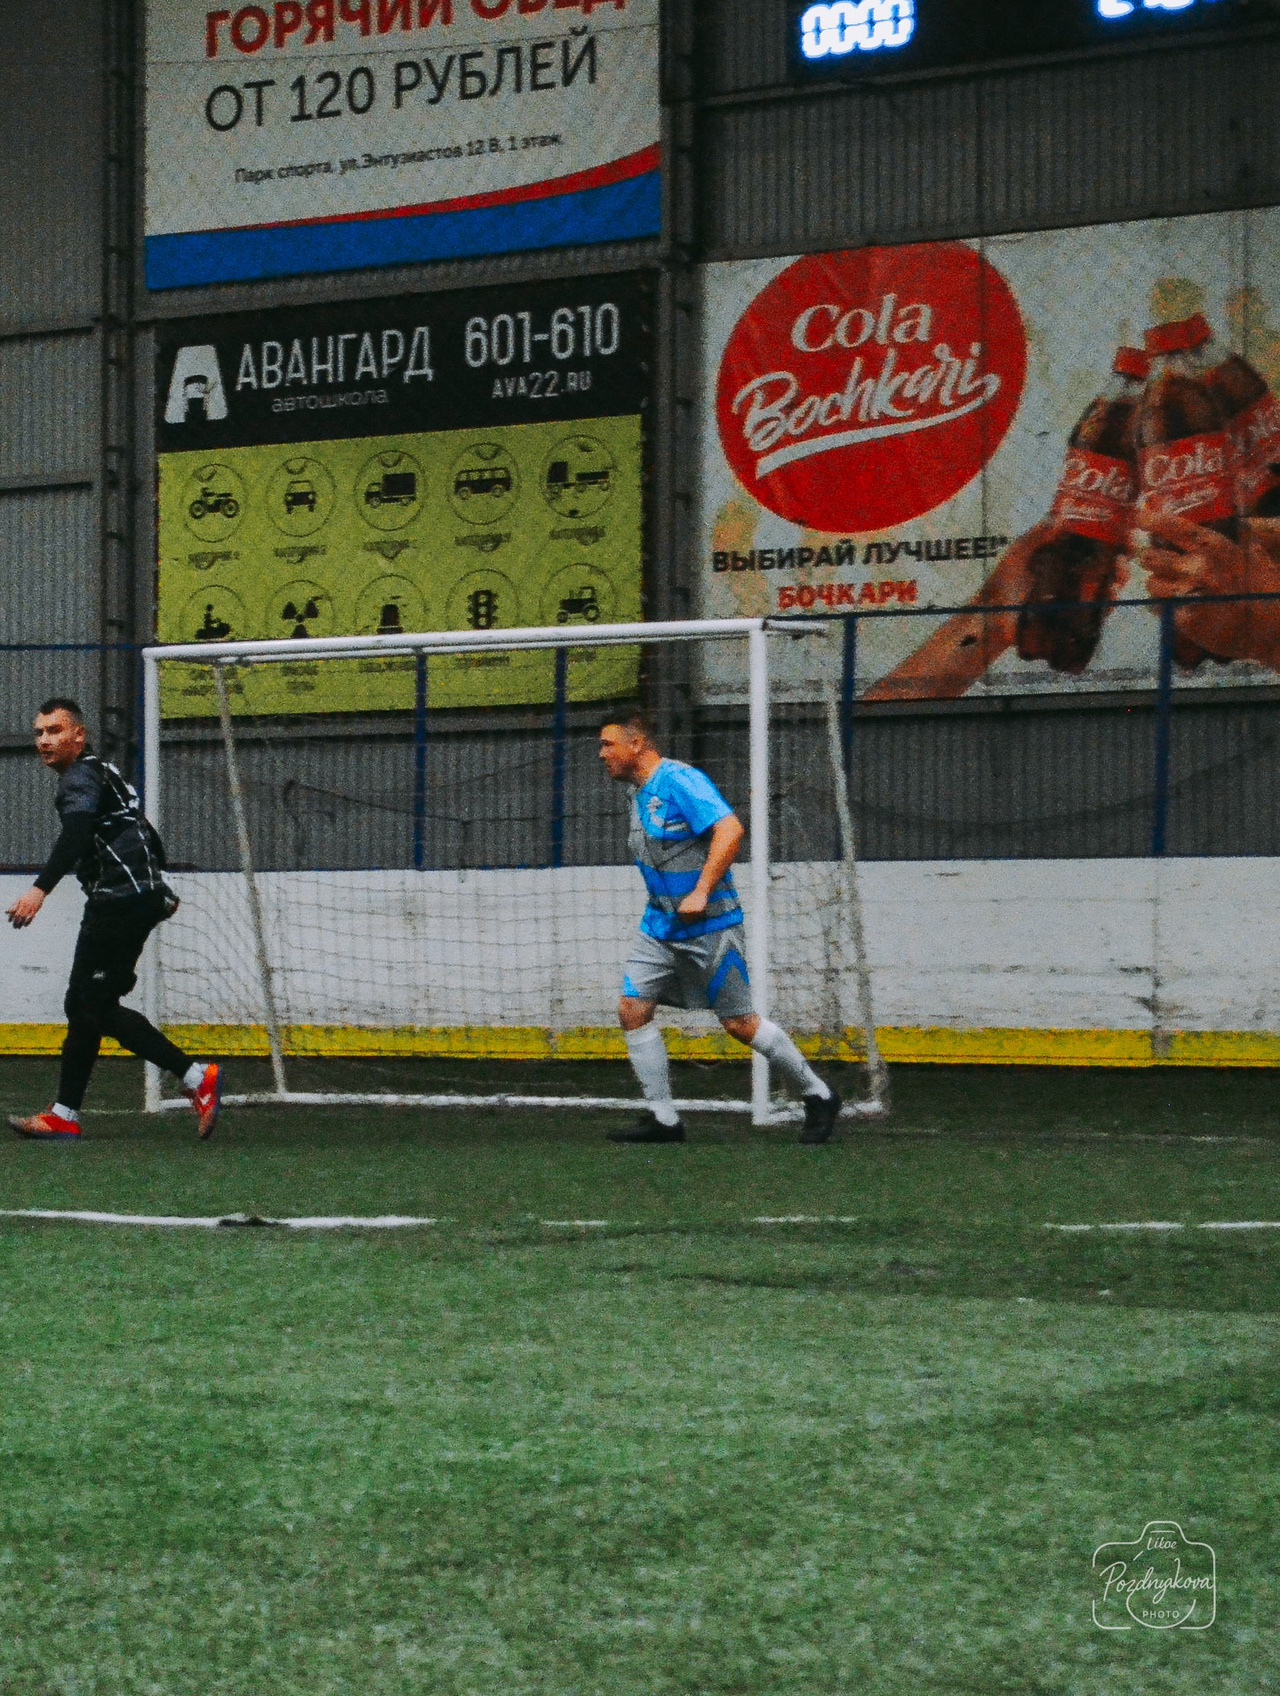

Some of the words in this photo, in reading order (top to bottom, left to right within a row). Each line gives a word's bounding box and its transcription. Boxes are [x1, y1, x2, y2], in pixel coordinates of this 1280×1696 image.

[204, 78, 276, 131] ОТ
[289, 65, 376, 123] 120
[393, 25, 598, 109] РУБЛЕЙ
[234, 167, 274, 185] Парк
[466, 139, 485, 157] 12
[507, 135, 518, 151] 1
[521, 133, 563, 149] этаж
[235, 326, 434, 391] АВАНГАРД
[464, 302, 620, 368] 601-610
[790, 293, 933, 352] Cola
[271, 389, 389, 413] автошкола
[491, 369, 593, 399] AVA22.RU
[731, 341, 1002, 452] Bochkari
[712, 538, 854, 572] ВЫБИРАЙ
[777, 580, 918, 610] БОЧКАРИ
